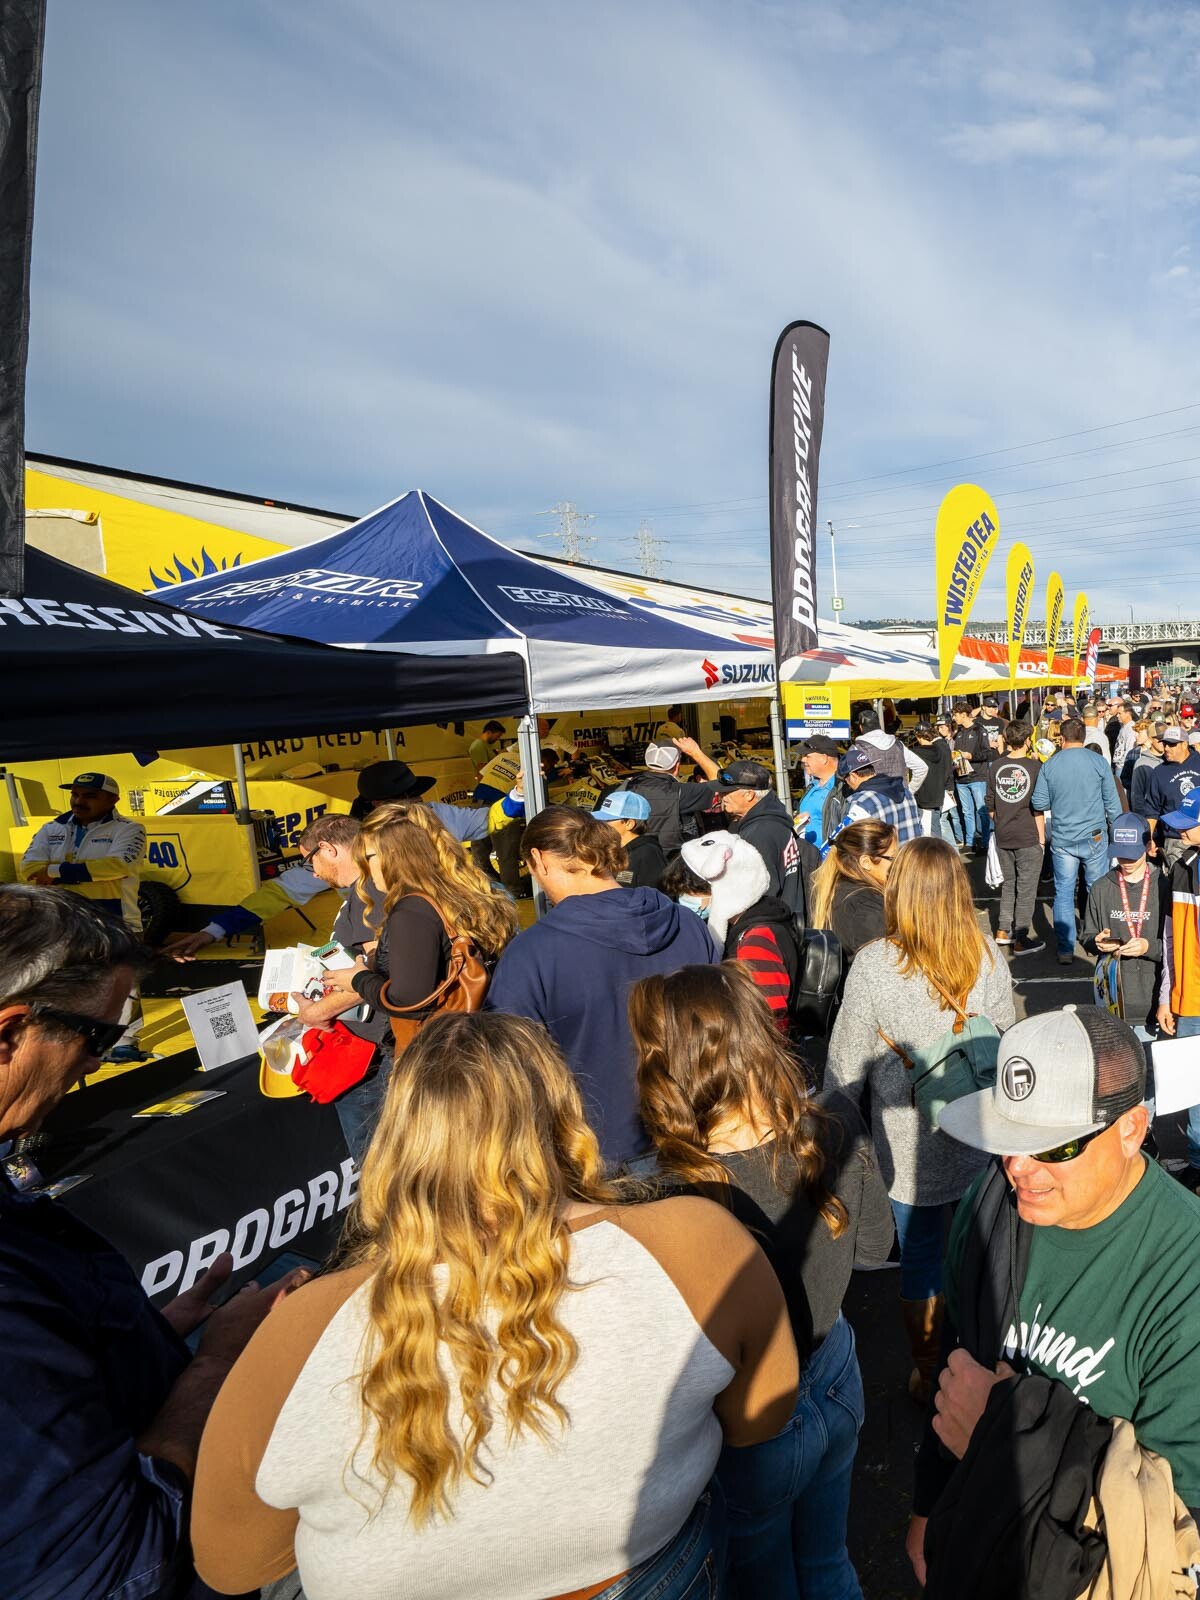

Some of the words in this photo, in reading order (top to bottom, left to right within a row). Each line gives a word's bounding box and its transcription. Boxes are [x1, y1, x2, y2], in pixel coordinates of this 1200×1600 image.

[945, 541, 977, 627] TWISTED
[966, 512, 996, 548] TEA
[967, 582, 975, 602] HARD
[981, 549, 989, 560] TEA
[310, 595, 413, 608] CHEMICAL
[833, 598, 842, 610] B
[1012, 584, 1027, 642] TWISTED
[1021, 561, 1033, 586] TEA
[722, 664, 775, 684] SUZUKI
[242, 737, 304, 764] HARD
[315, 731, 362, 749] ICED
[373, 730, 406, 747] TA
[149, 842, 179, 868] 40
[140, 1156, 361, 1298] PROGRE
